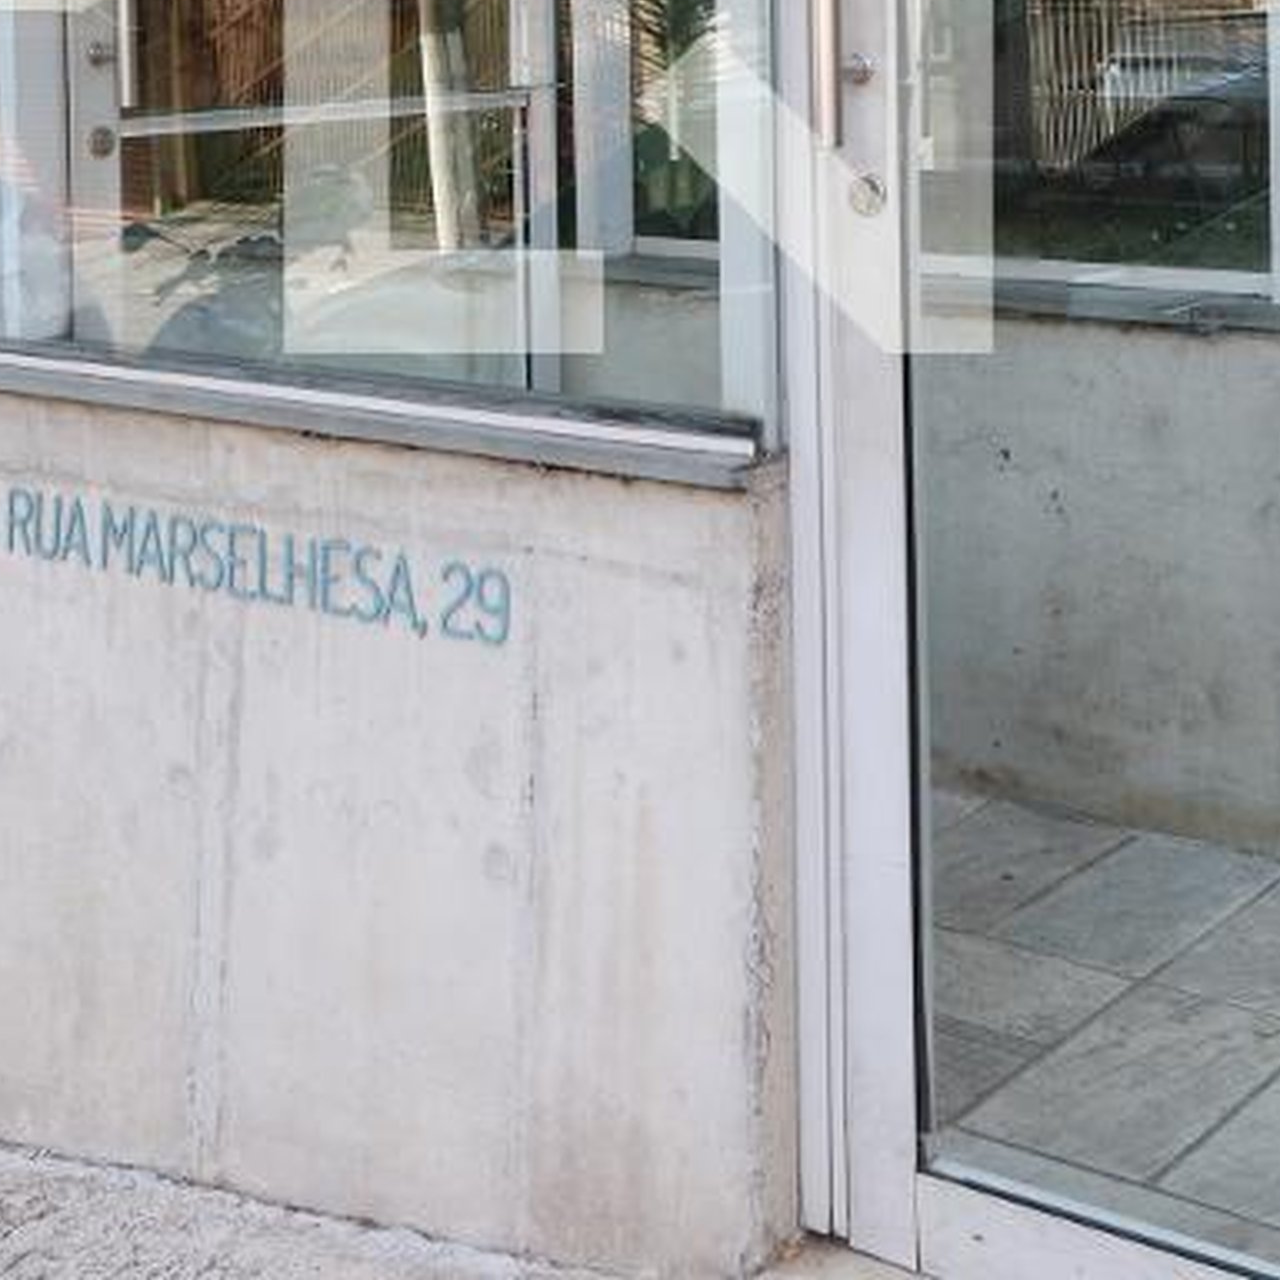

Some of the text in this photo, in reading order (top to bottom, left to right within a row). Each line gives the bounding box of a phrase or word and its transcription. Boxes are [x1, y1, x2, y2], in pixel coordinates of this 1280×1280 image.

[8, 488, 511, 645] RUA MARSELHESA, 29
